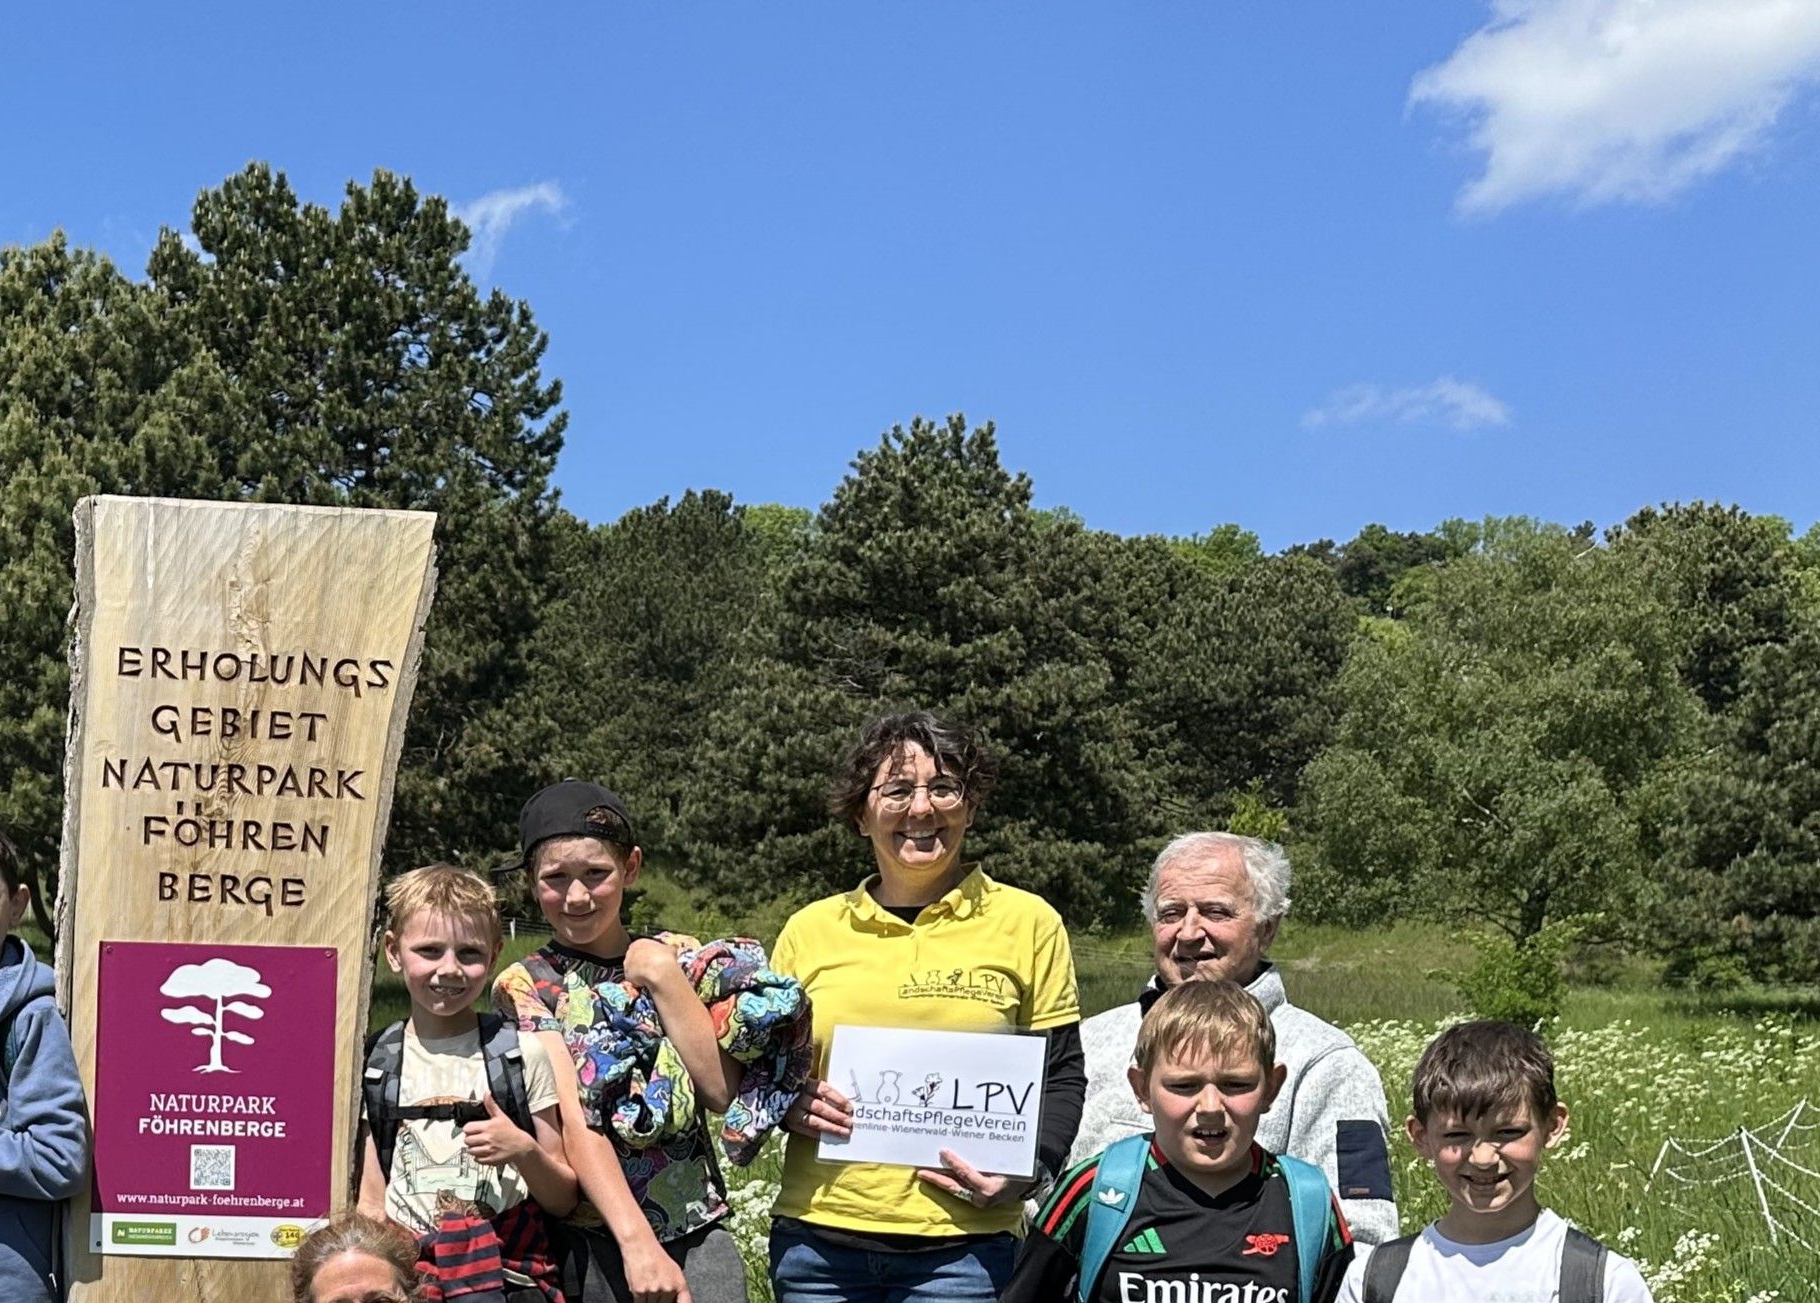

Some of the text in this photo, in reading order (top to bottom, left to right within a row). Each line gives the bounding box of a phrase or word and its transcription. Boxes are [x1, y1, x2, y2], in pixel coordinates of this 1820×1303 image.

[117, 646, 394, 698] ERHOLUNGS
[150, 705, 329, 744] GEBIET
[101, 756, 367, 801] NATURPARK
[142, 801, 330, 858] FÖHREN
[158, 872, 307, 917] BERGE
[149, 1092, 277, 1115] NATURPARK
[951, 1078, 1035, 1115] LPV
[138, 1114, 287, 1138] FÖHRENBERGE
[854, 1105, 1027, 1132] dschaftsPflegeVerein
[988, 1131, 1025, 1143] Becken
[116, 1193, 305, 1210] www.naturpark-foehrenberge.at
